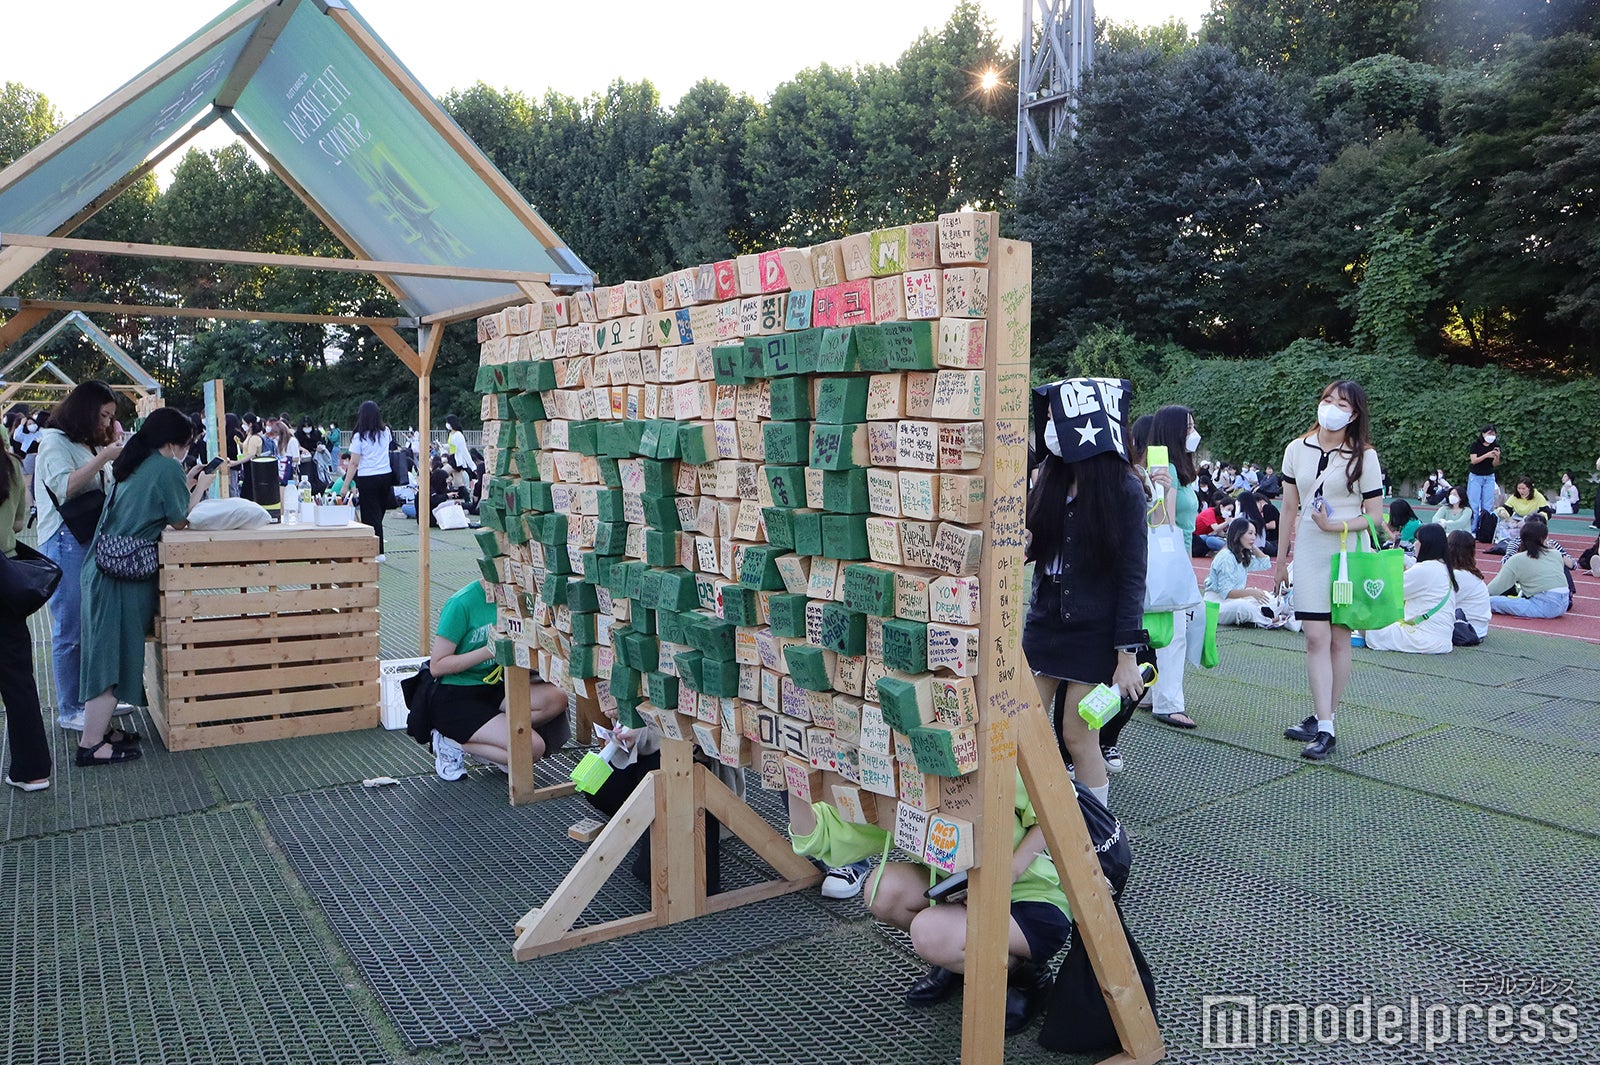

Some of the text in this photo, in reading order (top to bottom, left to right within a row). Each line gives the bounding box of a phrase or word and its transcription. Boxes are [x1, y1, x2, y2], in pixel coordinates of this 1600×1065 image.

[936, 585, 951, 599] YO
[936, 601, 961, 612] DREAM
[825, 610, 840, 629] NCT
[823, 614, 850, 645] DREAM
[930, 629, 951, 637] Dream
[758, 714, 809, 762] 마크
[934, 822, 955, 838] NCT
[931, 833, 956, 849] DREAM
